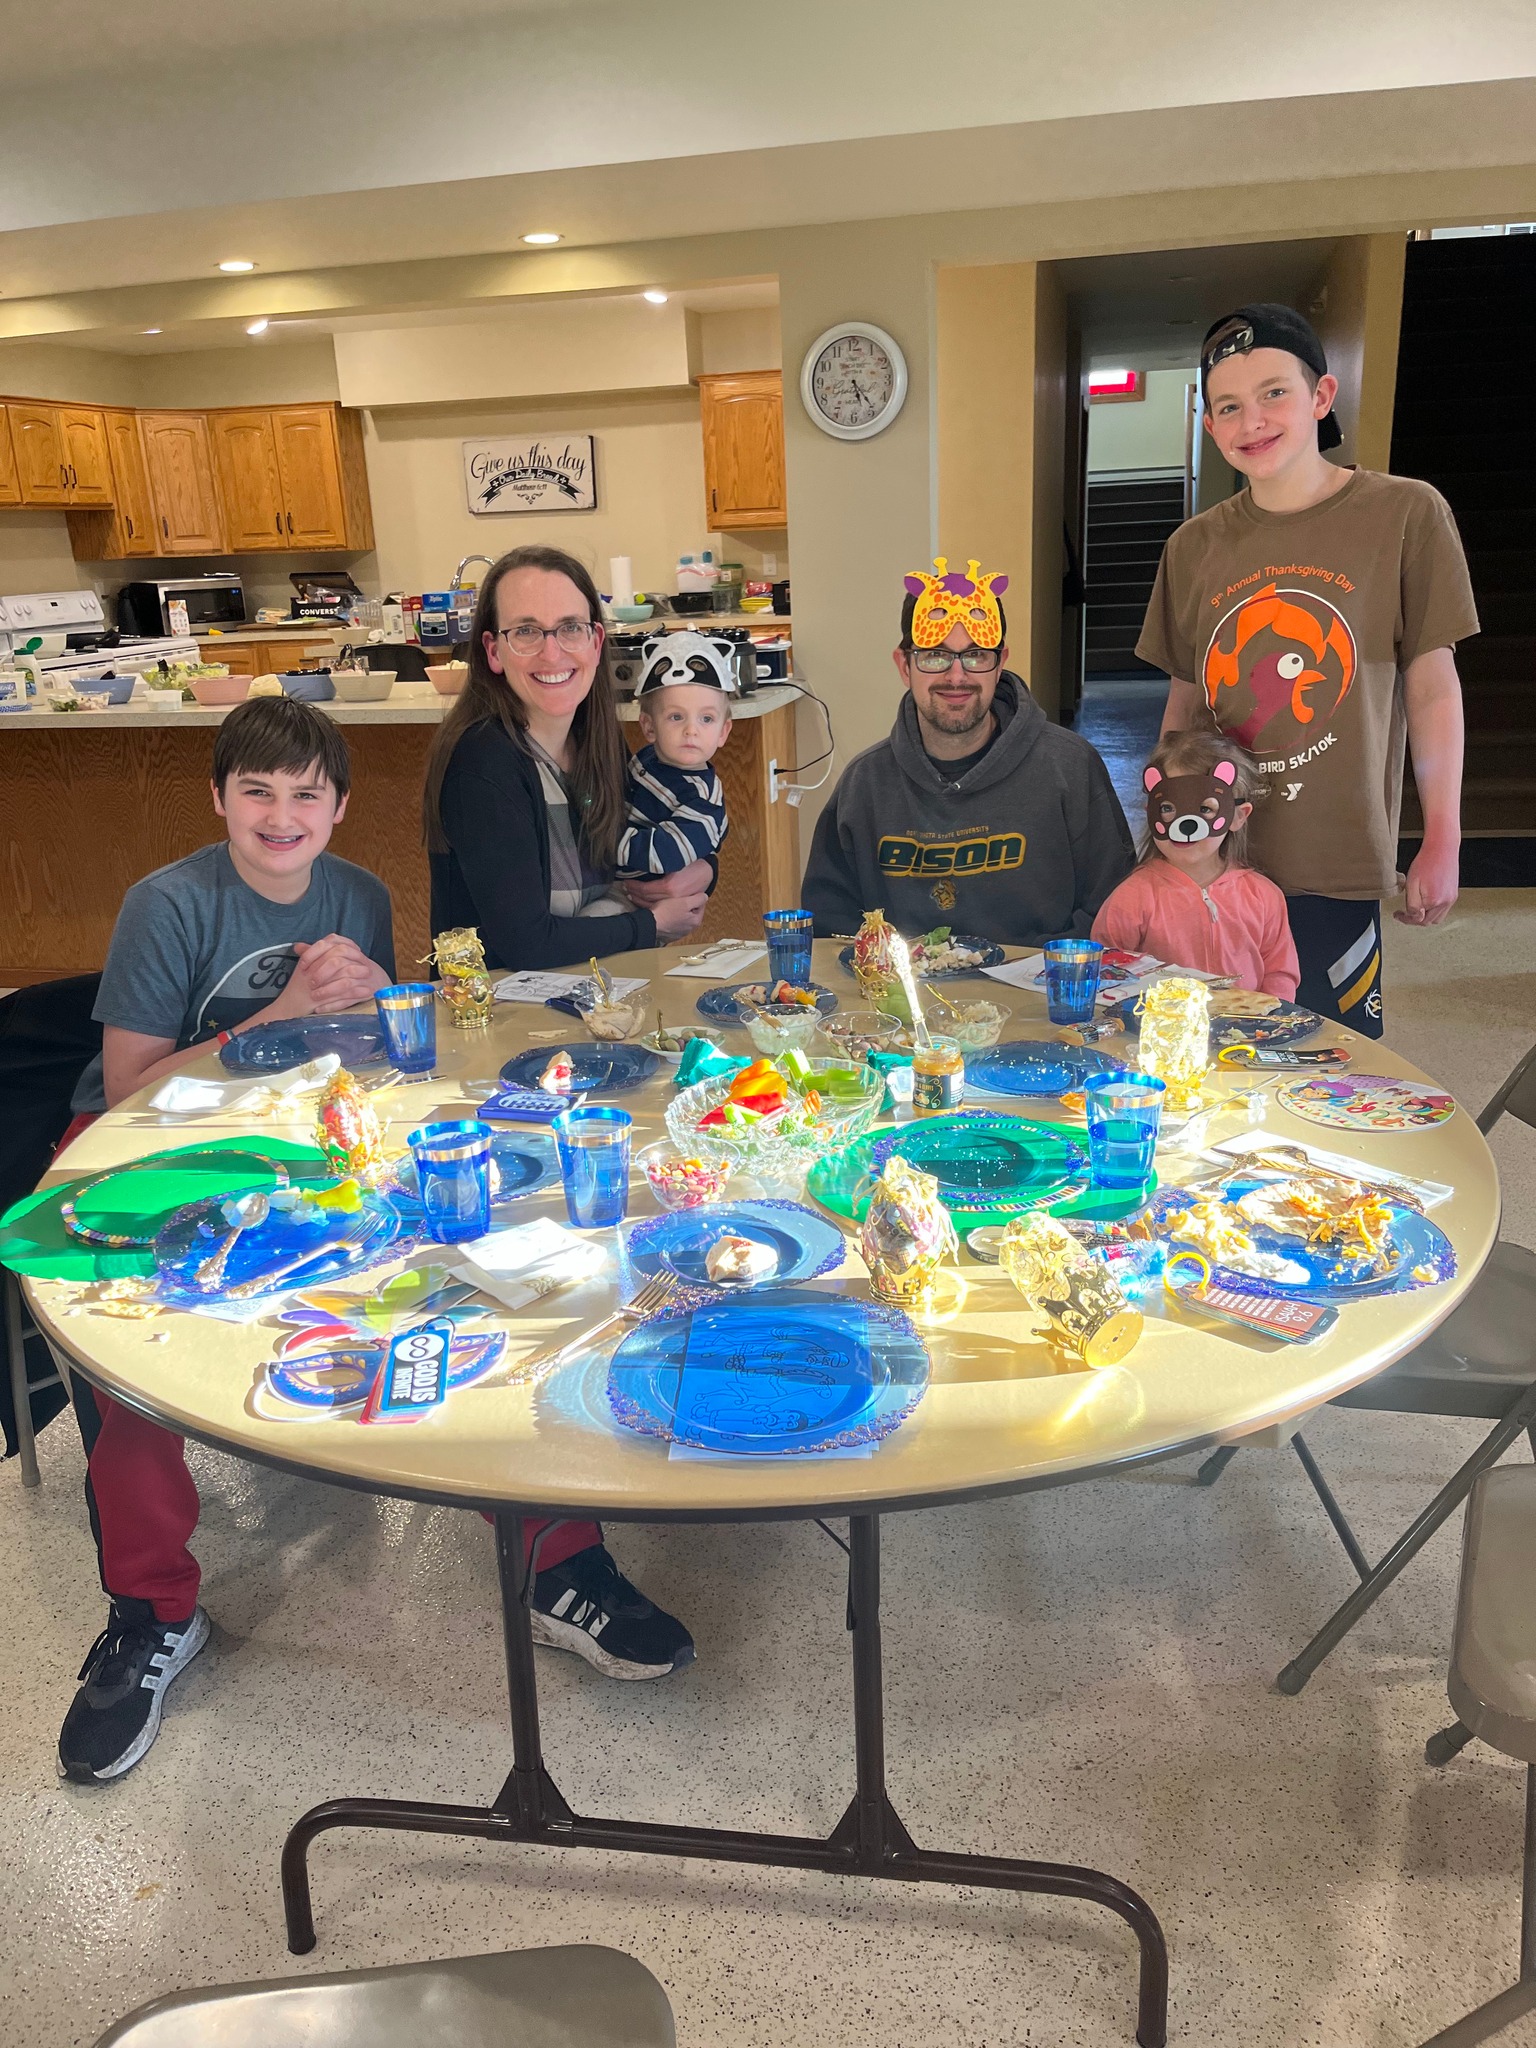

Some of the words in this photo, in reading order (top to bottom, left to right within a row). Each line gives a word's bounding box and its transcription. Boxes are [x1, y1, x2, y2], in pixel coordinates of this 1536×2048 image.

[832, 346, 841, 358] 11
[848, 340, 862, 352] 12
[869, 344, 875, 356] 1
[820, 360, 832, 373] 10
[816, 377, 824, 389] 9
[884, 374, 892, 386] 3
[821, 393, 828, 405] 8
[880, 391, 888, 403] 4
[850, 412, 858, 424] 6
[471, 451, 504, 485] Give
[508, 455, 524, 471] us
[527, 442, 552, 469] this
[557, 444, 587, 481] day
[1226, 569, 1261, 597] Annual
[1264, 563, 1335, 583] Thanksgiving
[1334, 573, 1356, 594] Day
[1258, 760, 1286, 774] BIRD
[1288, 732, 1338, 770] 5K/10K
[956, 825, 990, 837] UNIVERSITY
[248, 954, 300, 990] Fo
[1274, 1302, 1301, 1323] ISAIAH
[414, 1360, 439, 1387] GOD
[411, 1387, 436, 1402] IS
